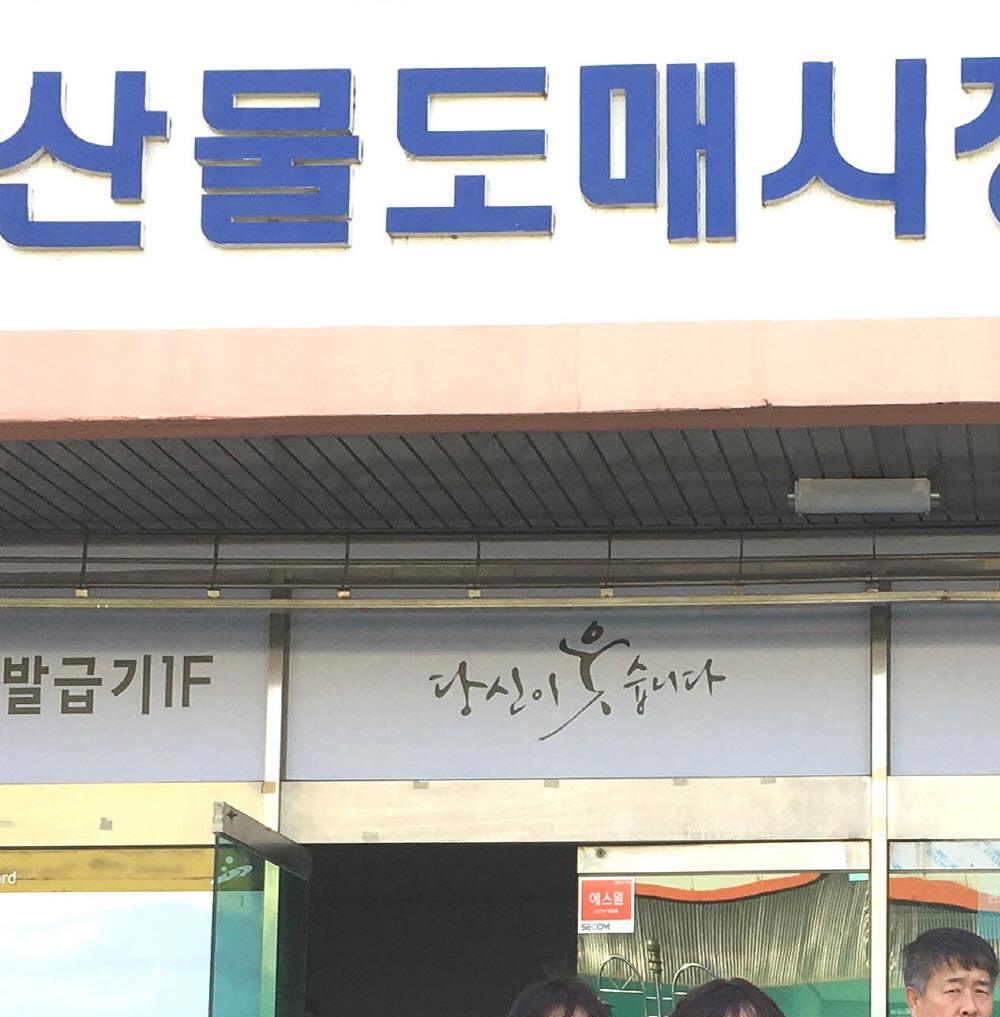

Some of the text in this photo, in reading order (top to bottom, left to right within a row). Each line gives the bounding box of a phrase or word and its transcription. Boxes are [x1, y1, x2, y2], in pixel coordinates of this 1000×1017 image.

[429, 660, 559, 716] 당신이
[588, 891, 625, 906] 에스원
[581, 923, 610, 931] SECOM
